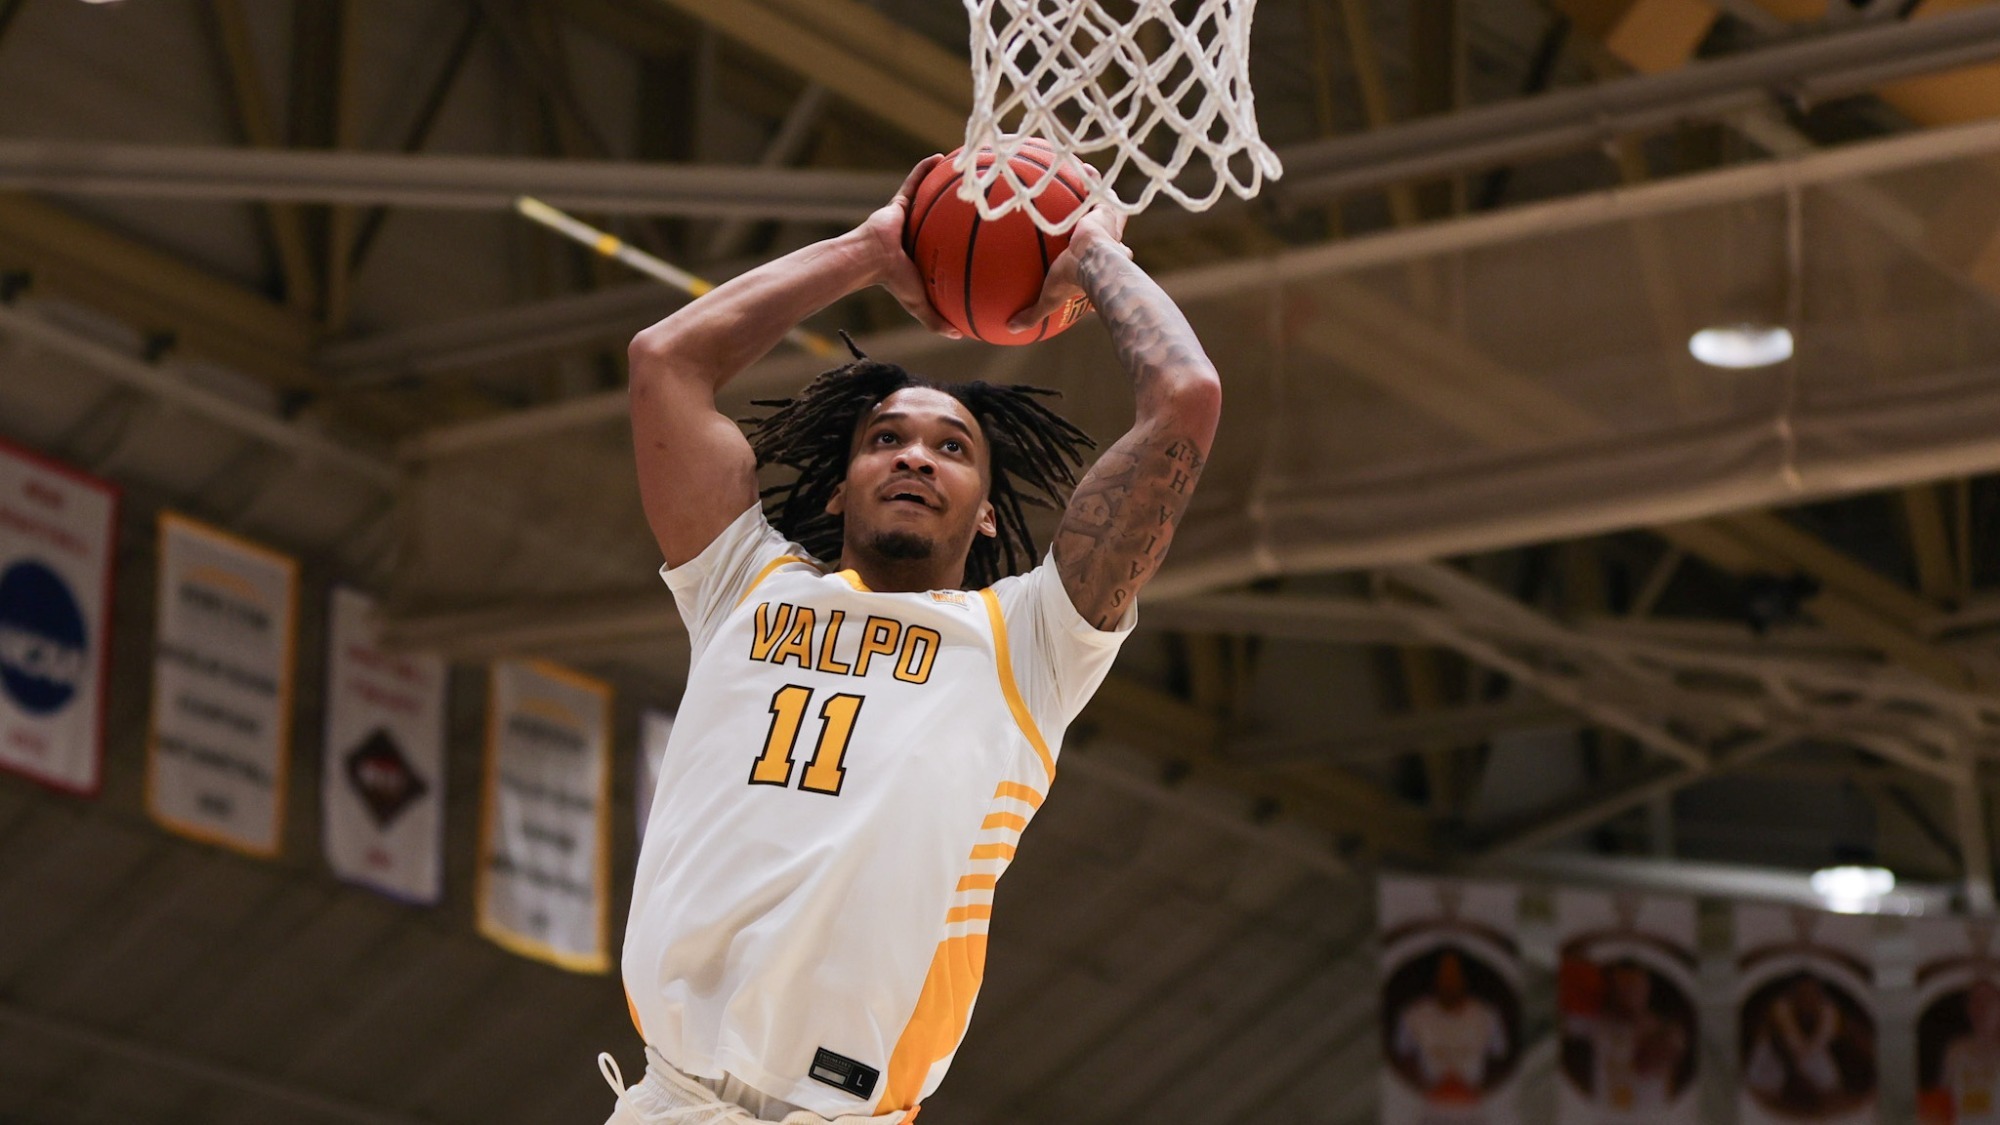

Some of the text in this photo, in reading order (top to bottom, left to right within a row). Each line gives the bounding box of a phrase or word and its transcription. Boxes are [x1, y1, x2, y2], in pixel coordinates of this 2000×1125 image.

[750, 602, 941, 684] VALPO
[748, 684, 866, 796] 11
[856, 1074, 863, 1087] L
